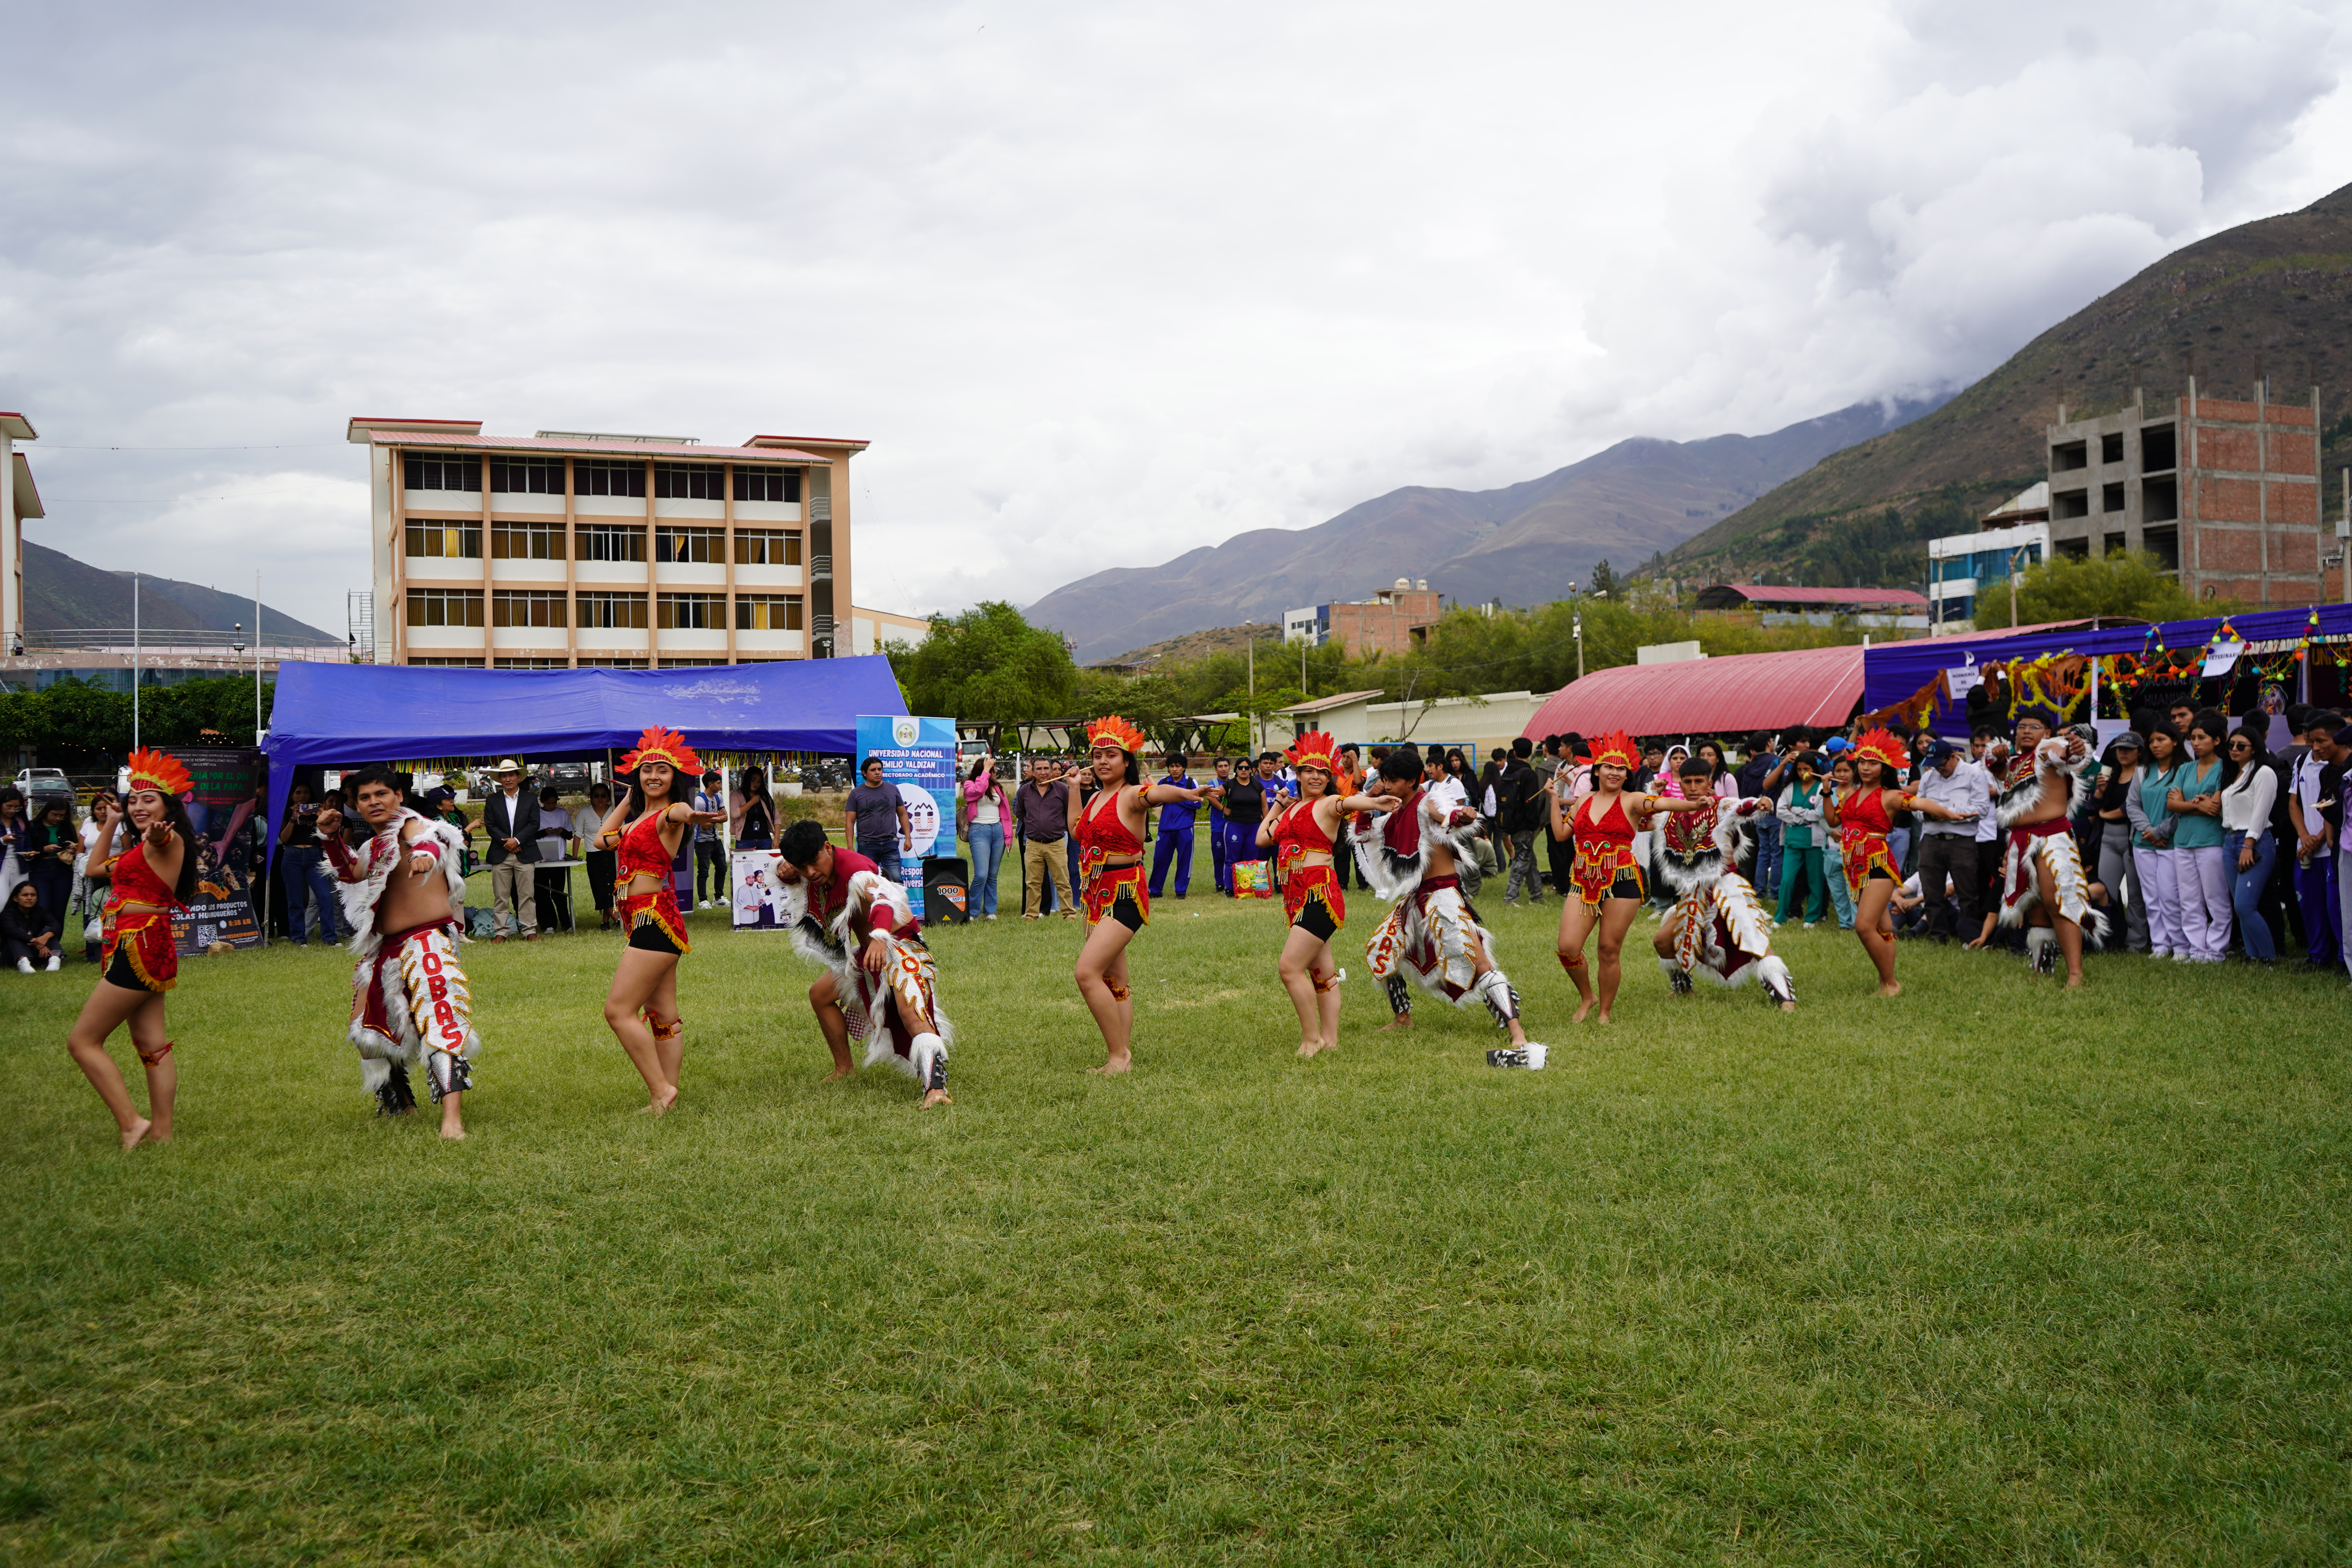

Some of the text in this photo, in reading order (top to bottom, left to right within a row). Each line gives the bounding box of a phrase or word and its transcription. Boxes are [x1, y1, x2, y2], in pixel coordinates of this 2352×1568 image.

[869, 749, 910, 758] UNIVERSIDAD
[906, 761, 936, 769] VALDIZAN
[236, 771, 249, 780] DÍA
[210, 783, 221, 791] LA
[216, 901, 247, 910] PRODUCTOS
[413, 931, 463, 1050] TOBAS
